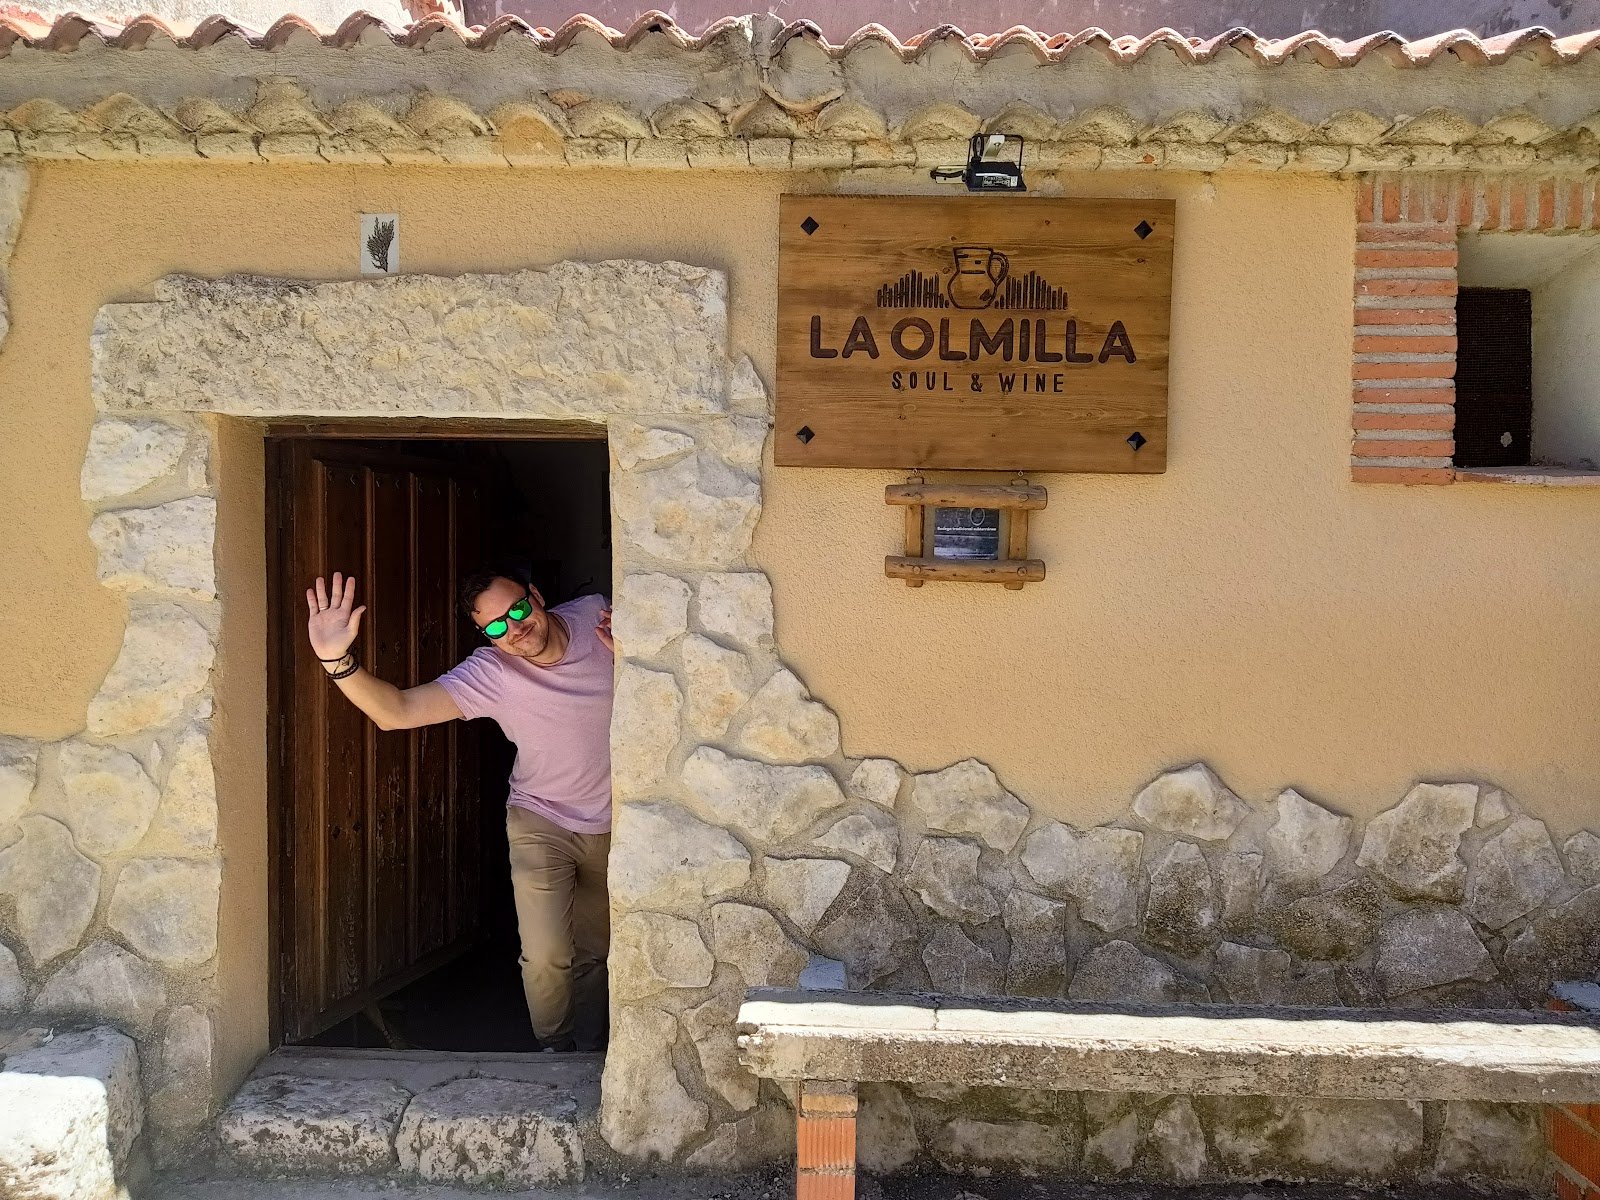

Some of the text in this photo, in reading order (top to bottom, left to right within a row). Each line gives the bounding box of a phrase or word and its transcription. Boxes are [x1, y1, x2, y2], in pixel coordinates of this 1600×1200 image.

[810, 315, 1137, 364] LA OLMILLA
[892, 371, 1064, 393] SOUL & WINE
